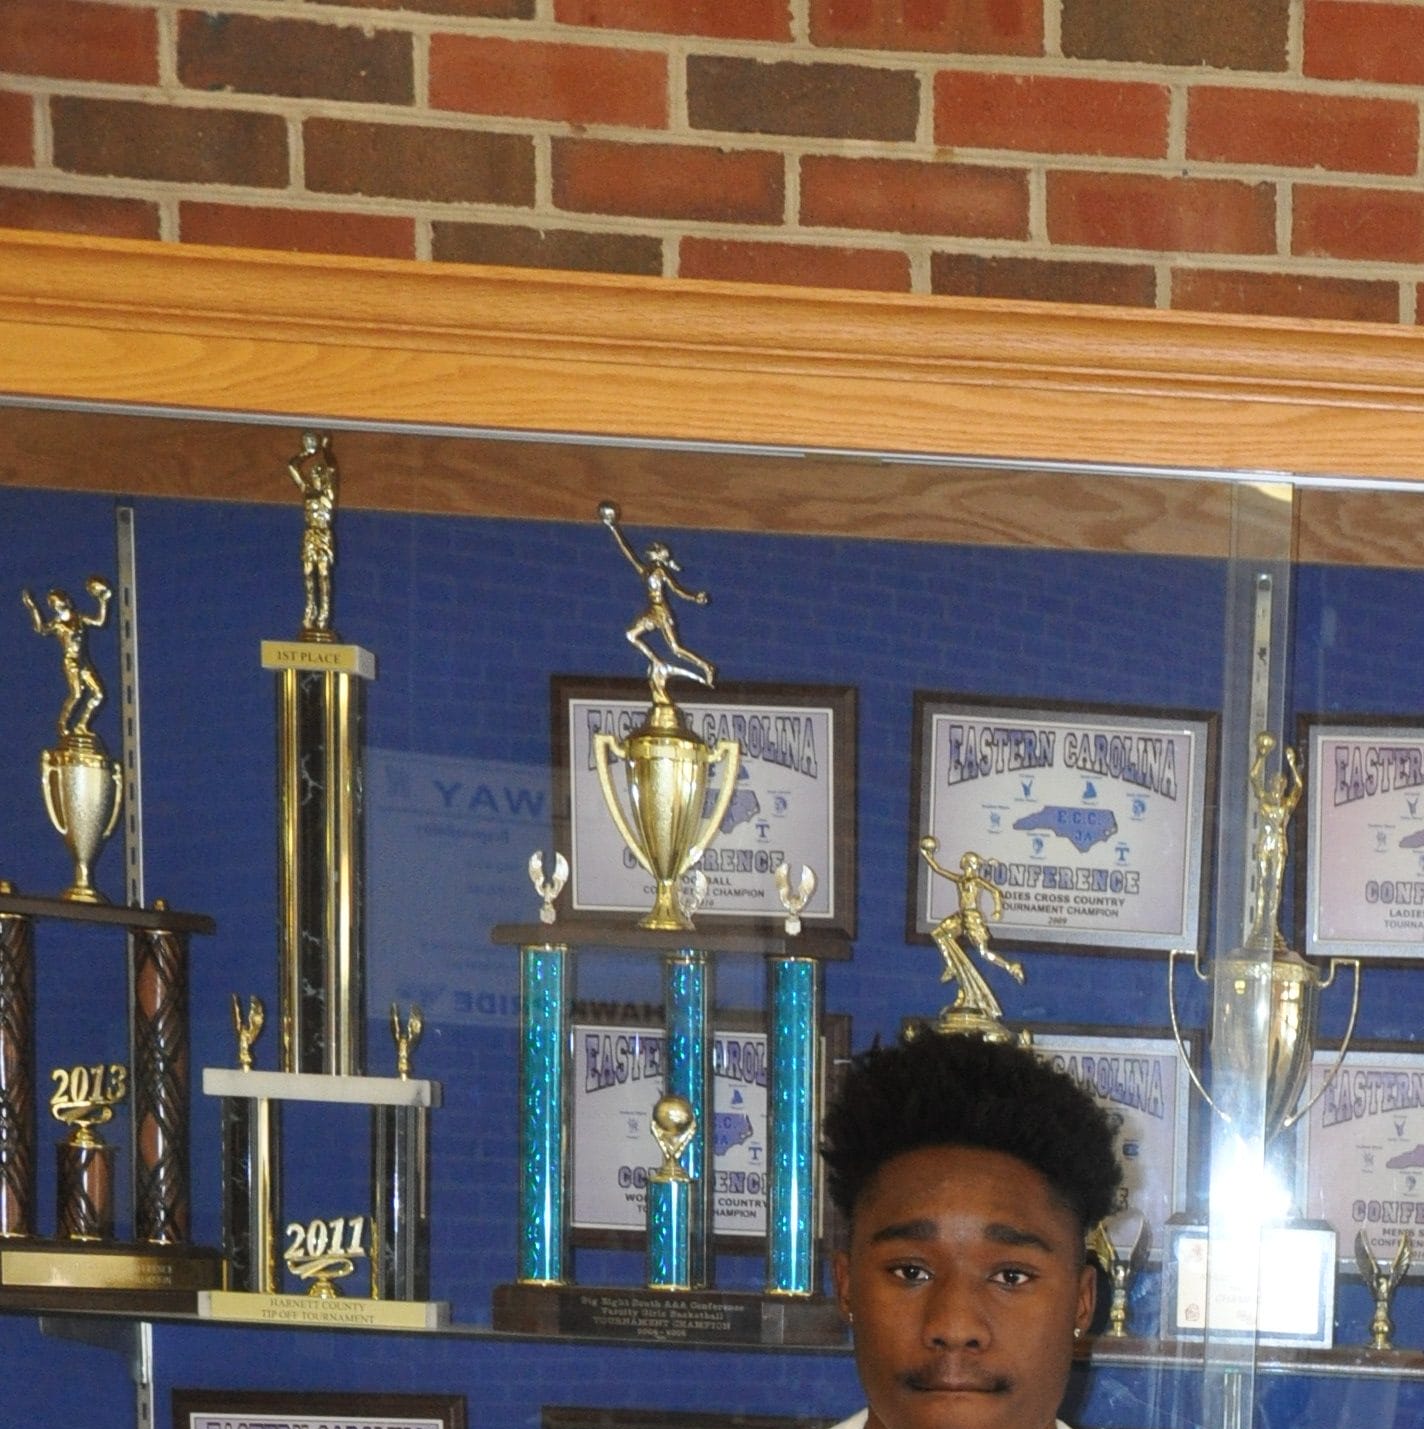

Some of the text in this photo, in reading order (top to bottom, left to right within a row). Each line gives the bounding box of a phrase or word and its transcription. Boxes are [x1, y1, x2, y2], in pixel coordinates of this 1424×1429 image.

[278, 651, 338, 663] 1ST PLACE
[701, 713, 818, 779] CAROLINA
[948, 725, 1176, 800] EASTERN CAROLINA
[980, 864, 1140, 894] CONFERENCE
[713, 889, 765, 898] CHAMPION
[1035, 894, 1125, 906] CROSS COUNTRY
[1001, 904, 1119, 917] OURNAMENT CHAMPION
[51, 1065, 126, 1103] 2013
[285, 1216, 366, 1257] 2011
[270, 1298, 365, 1313] HARNETT COUNTY
[301, 1311, 374, 1324] TOURNAMENT
